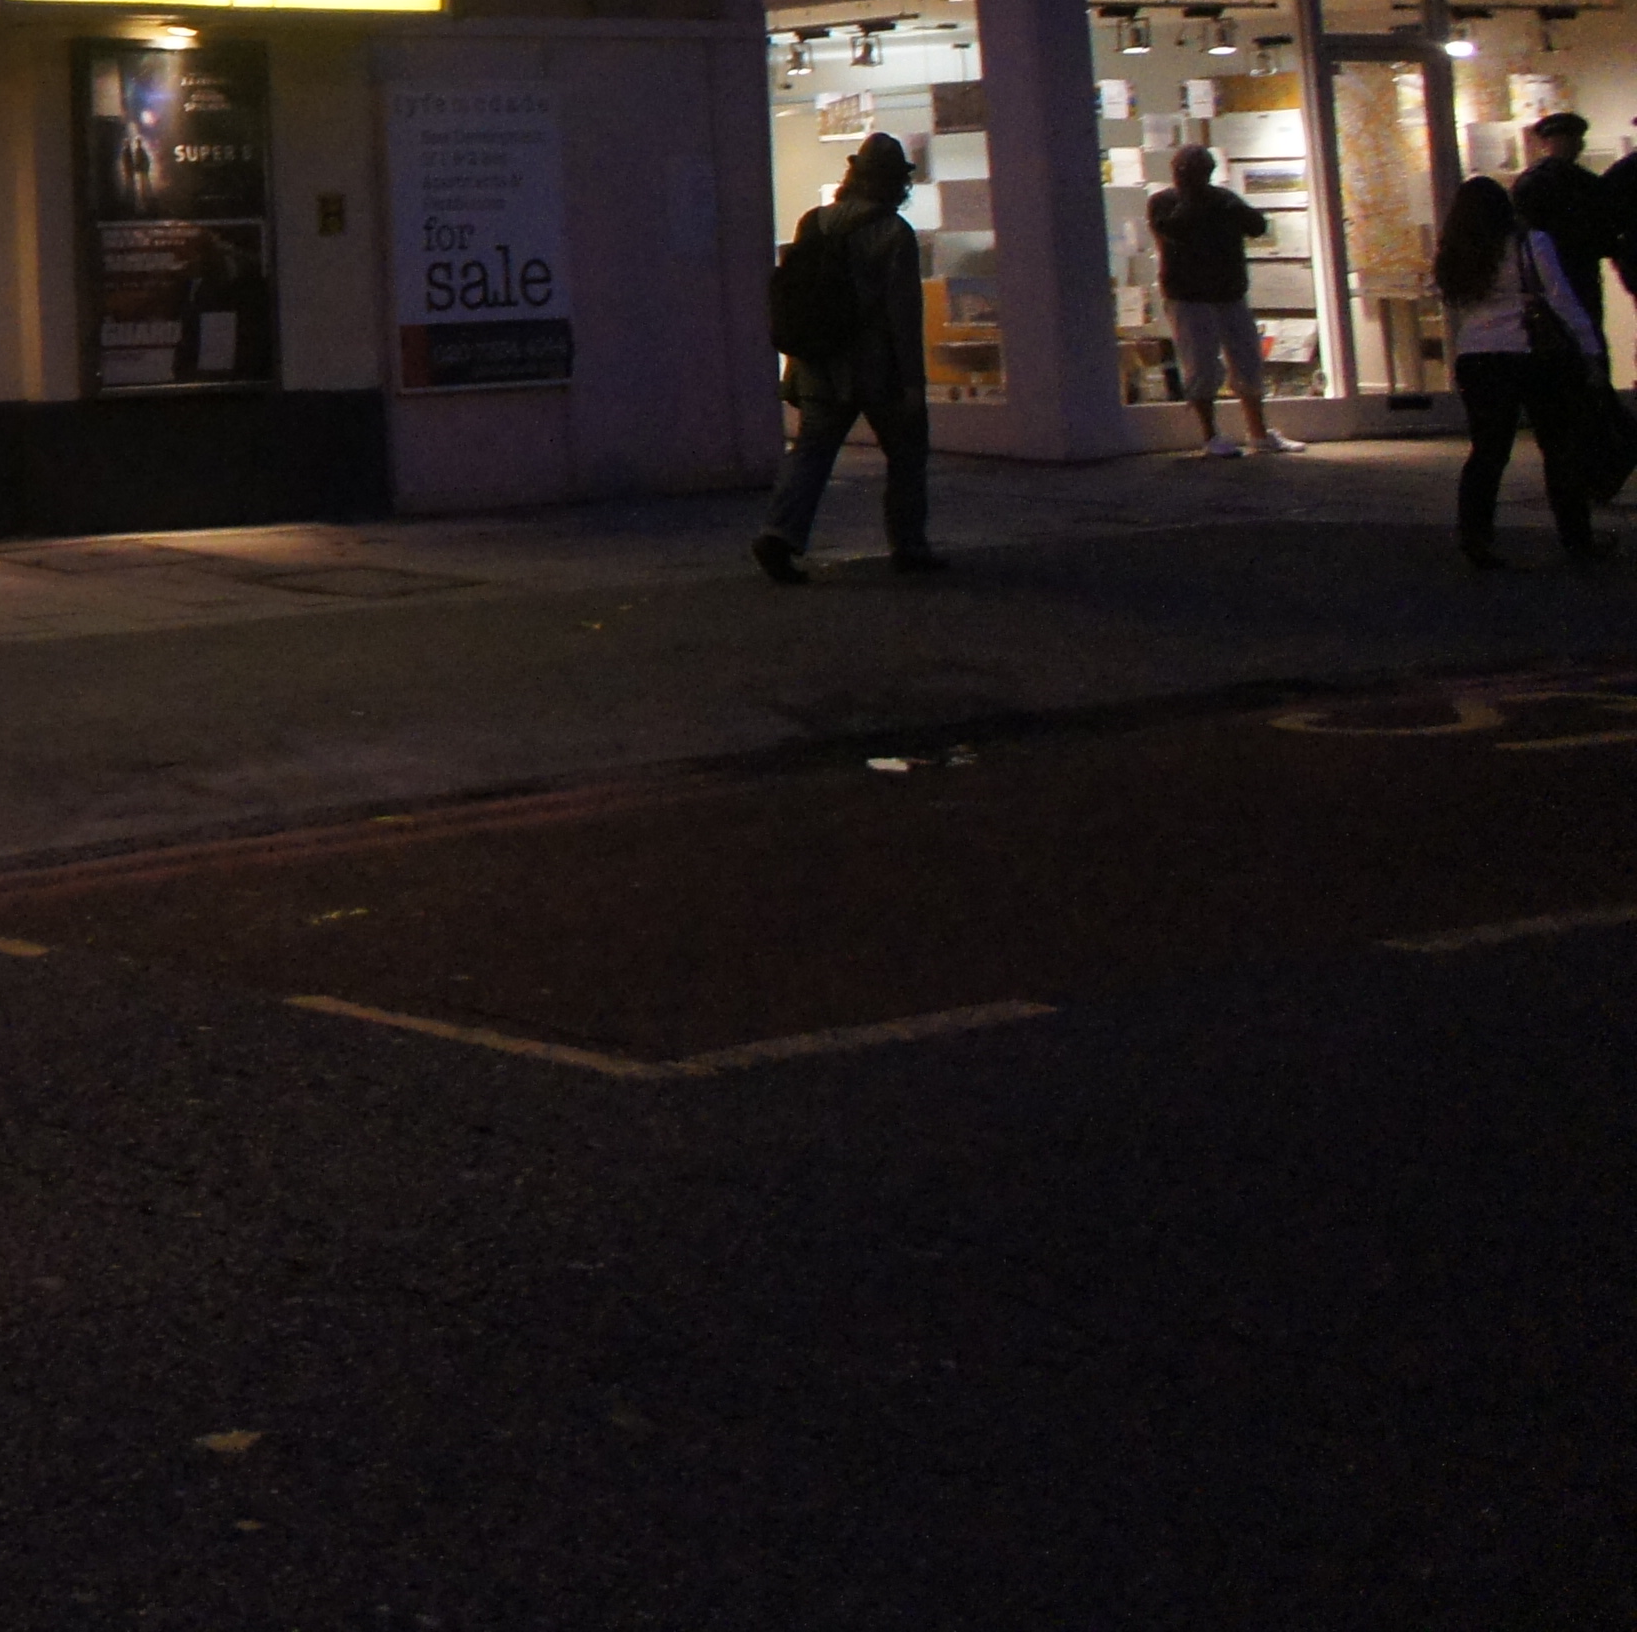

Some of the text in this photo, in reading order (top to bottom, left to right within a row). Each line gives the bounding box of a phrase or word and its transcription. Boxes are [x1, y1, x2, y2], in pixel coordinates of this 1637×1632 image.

[174, 144, 235, 162] SUPER
[424, 216, 474, 251] for
[427, 245, 552, 311] sale
